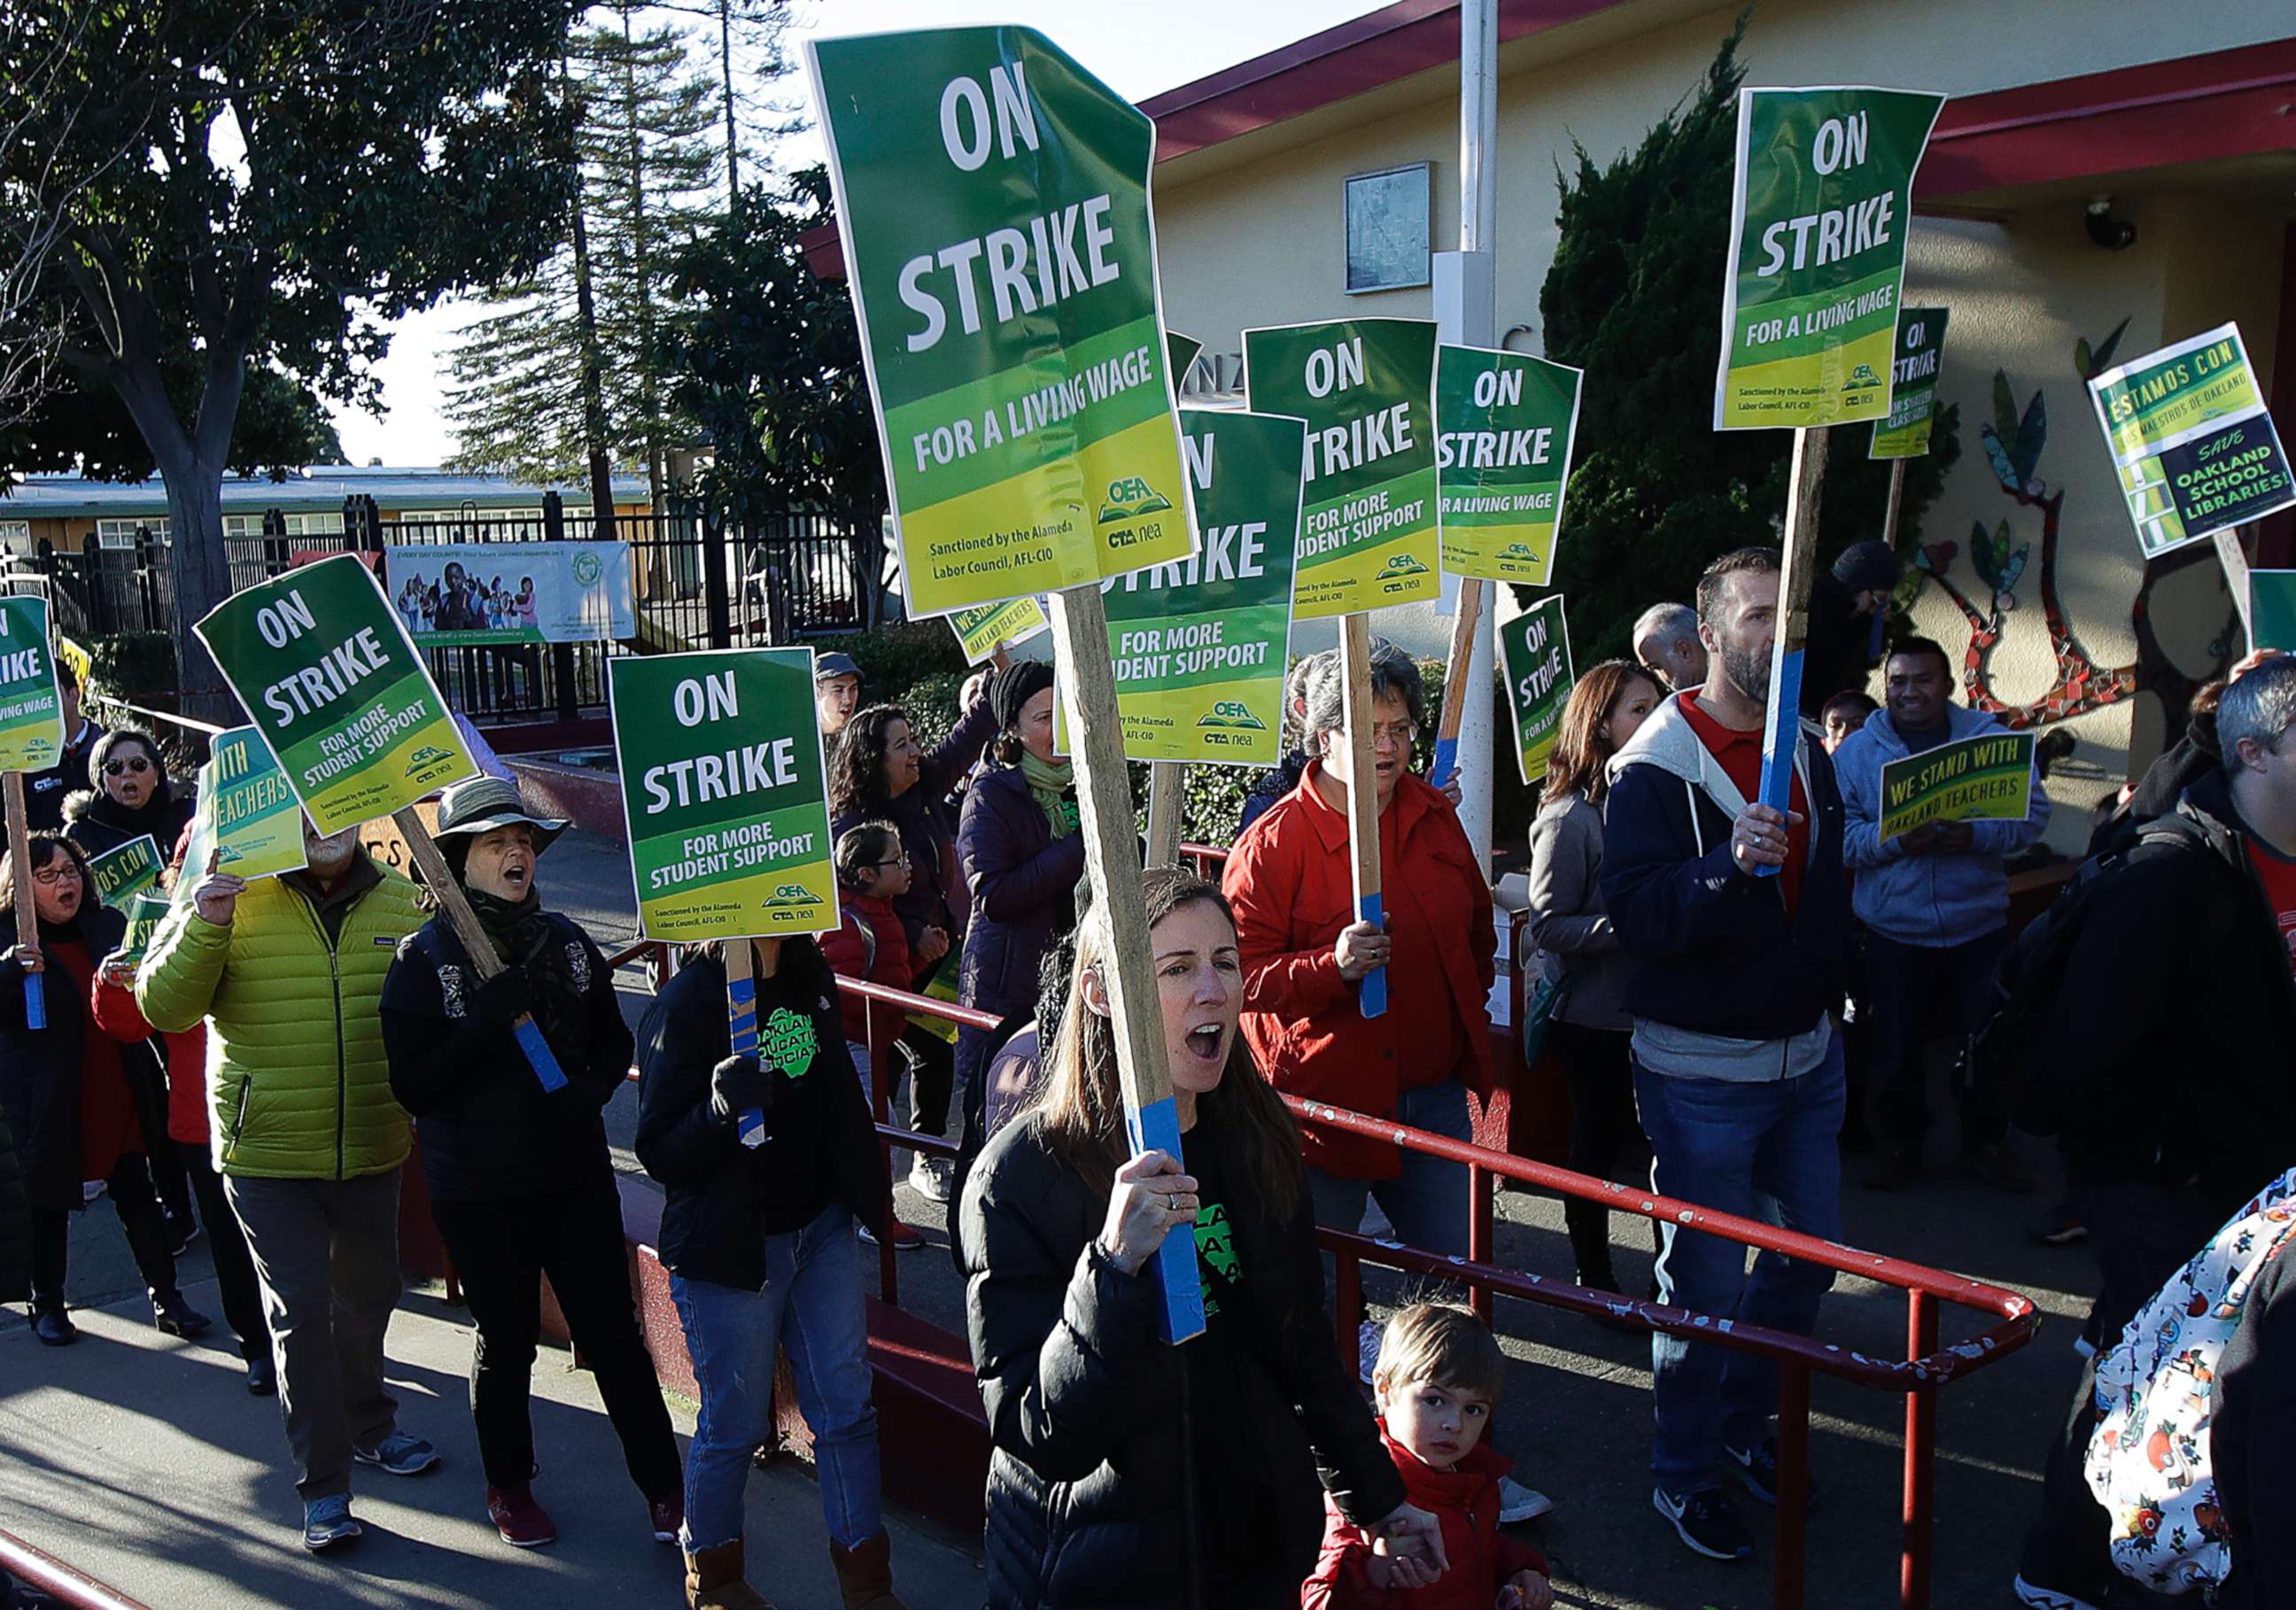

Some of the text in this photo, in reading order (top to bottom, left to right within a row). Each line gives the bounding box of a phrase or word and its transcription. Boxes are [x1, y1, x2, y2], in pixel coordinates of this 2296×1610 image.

[940, 61, 1039, 171] ON
[1812, 110, 1868, 175] ON
[1757, 191, 1894, 278] STRIKE
[897, 194, 1120, 352] STRIKE
[1746, 284, 1893, 347] FOR A LIVING WAGE
[1305, 337, 1365, 399] ON
[2110, 341, 2234, 423] ESTAMOS CON
[1474, 368, 1524, 408] ON
[2139, 403, 2189, 435] MAESTROS
[2190, 396, 2203, 412] DE
[2204, 371, 2246, 406] OAKLAND
[912, 418, 977, 472] FOR
[983, 408, 1004, 448] A
[1005, 377, 1086, 437] LIVING
[1085, 345, 1152, 404] WAGE
[1183, 432, 1215, 489] N
[1306, 402, 1413, 483] TRIKE
[1437, 428, 1552, 468] STRIKE
[2199, 430, 2245, 461] SAVE
[2177, 445, 2271, 488] OAKLAND
[2190, 463, 2270, 502] SCHOOL
[1108, 476, 1153, 505] OEA
[1452, 498, 1462, 513] A
[1462, 496, 1511, 513] LIVING
[1513, 492, 1553, 511] WAGE
[2185, 471, 2291, 521] LIBRARIES!
[1297, 525, 1349, 560] UDENT
[1353, 499, 1423, 543] SUPPORT
[1307, 490, 1389, 535] FOR MORE
[930, 521, 1074, 557] Sanctioned by the Alameda
[1108, 522, 1163, 550] CTA nea
[933, 547, 1054, 580] Labor Council, AFL-CIO
[1388, 553, 1416, 569] OEA
[1311, 584, 1319, 593] by
[257, 589, 317, 649] ON
[956, 611, 975, 632] WE
[970, 623, 1001, 654] OAKLAND
[999, 600, 1033, 634] TEACHERS
[1121, 621, 1223, 655] FOR MORE
[1525, 616, 1547, 654] ON
[0, 647, 42, 685] IKE
[264, 626, 391, 727] STRIKE
[1175, 641, 1268, 676] SUPPORT
[24, 696, 54, 715] WAGE
[673, 670, 739, 727] ON
[1214, 701, 1251, 718] OEA
[320, 702, 391, 757] FOR MORE
[1126, 731, 1153, 740] AFL-CIO
[1128, 716, 1140, 724] the
[1141, 716, 1175, 727] Alameda
[1204, 733, 1253, 746] CTA nea
[1524, 724, 1541, 742] FOR
[1540, 717, 1547, 730] A
[304, 700, 428, 788] STUDENT SUPPORT
[643, 736, 798, 815] STRIKE
[1891, 738, 2019, 807] WE STAND WITH
[1886, 778, 2018, 837] OAKLAND TEACHERS
[683, 821, 773, 858] FOR MORE
[120, 842, 151, 877] CON
[650, 832, 814, 890] STUDENT SUPPORT
[655, 902, 741, 917] Sanctioned by the Alameda
[775, 885, 808, 898] OEA
[655, 918, 676, 928] Labor
[676, 917, 701, 928] Council,
[796, 909, 814, 920] nea
[760, 1014, 812, 1042] AKLAN
